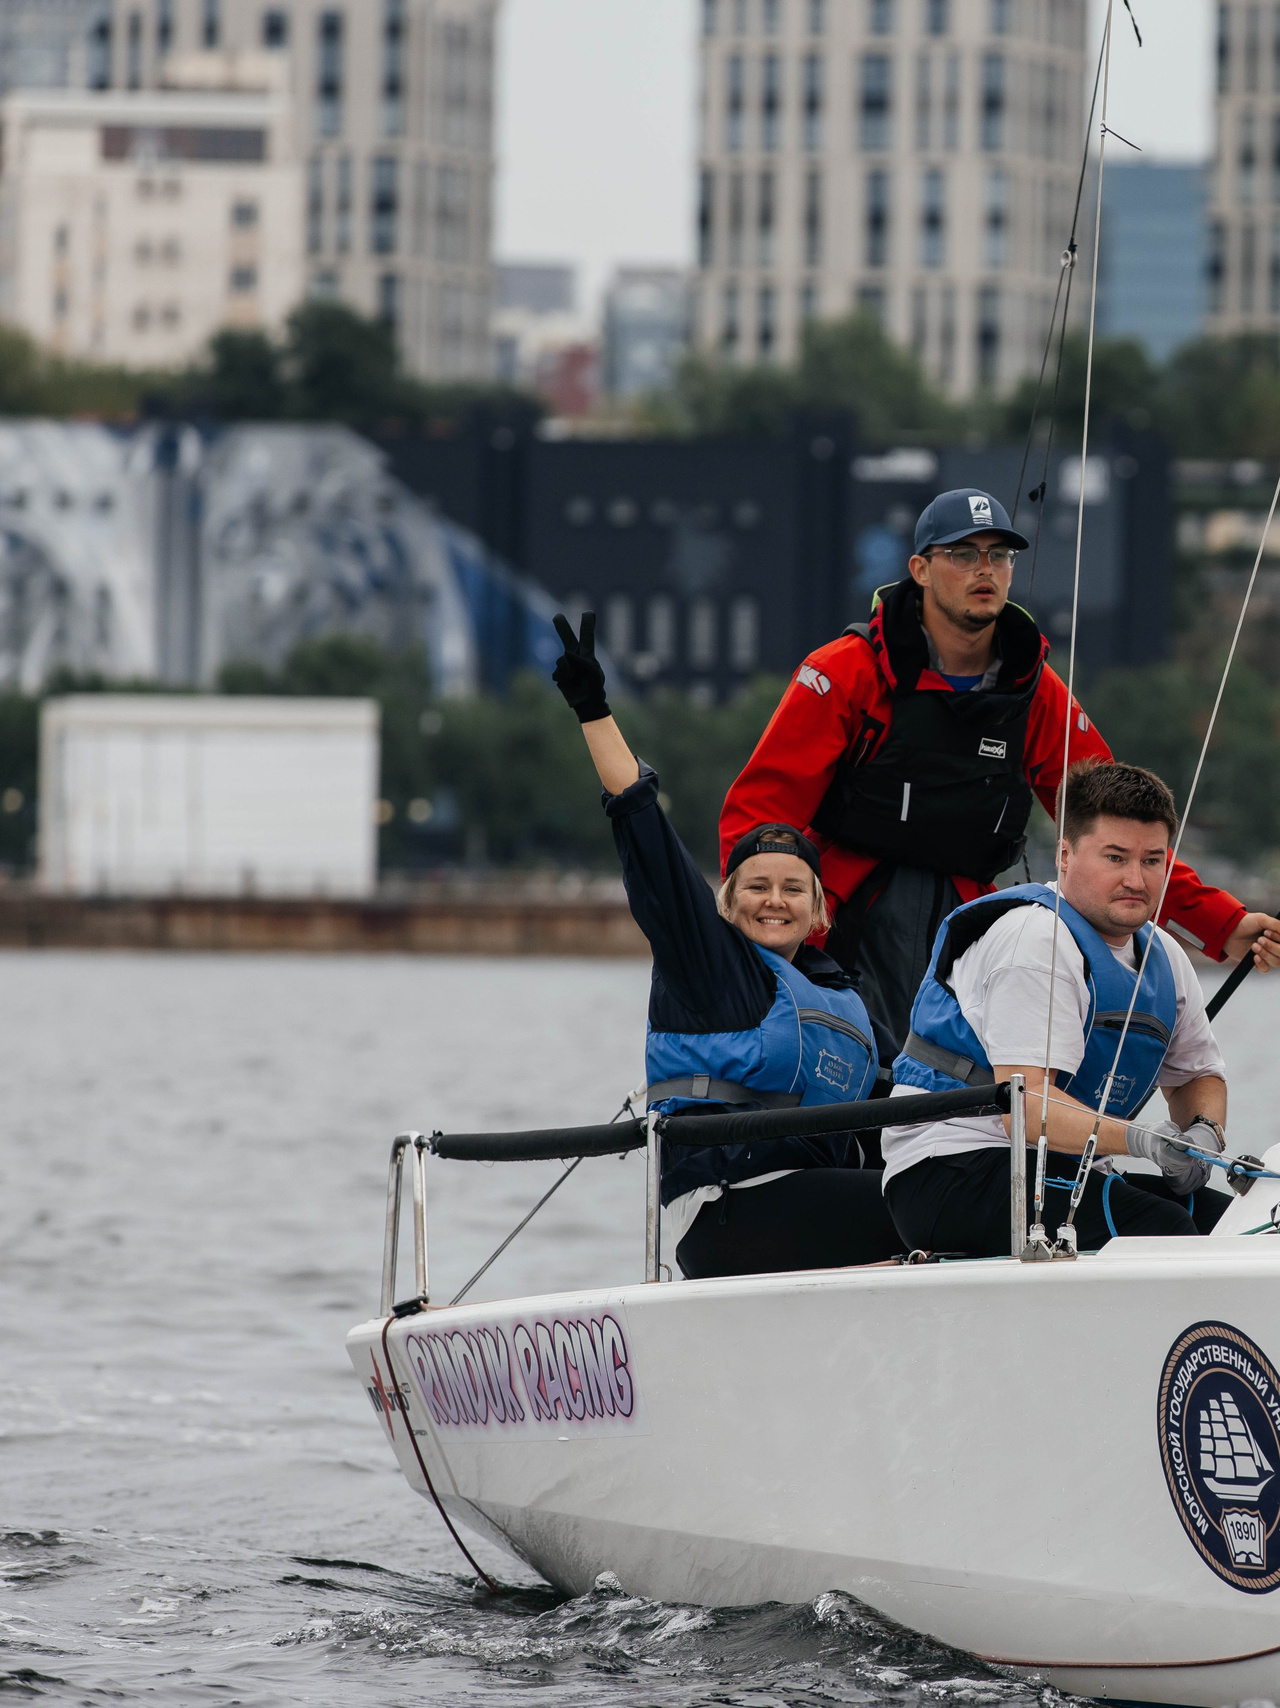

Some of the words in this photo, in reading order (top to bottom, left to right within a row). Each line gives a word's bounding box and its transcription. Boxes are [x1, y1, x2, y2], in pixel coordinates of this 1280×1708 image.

[513, 1314, 633, 1421] RACING
[1169, 1344, 1269, 1427] ГОСУДАРСТВЕННЫЙ
[1168, 1432, 1209, 1535] МОРСКОЙ
[1230, 1520, 1257, 1541] 1890
